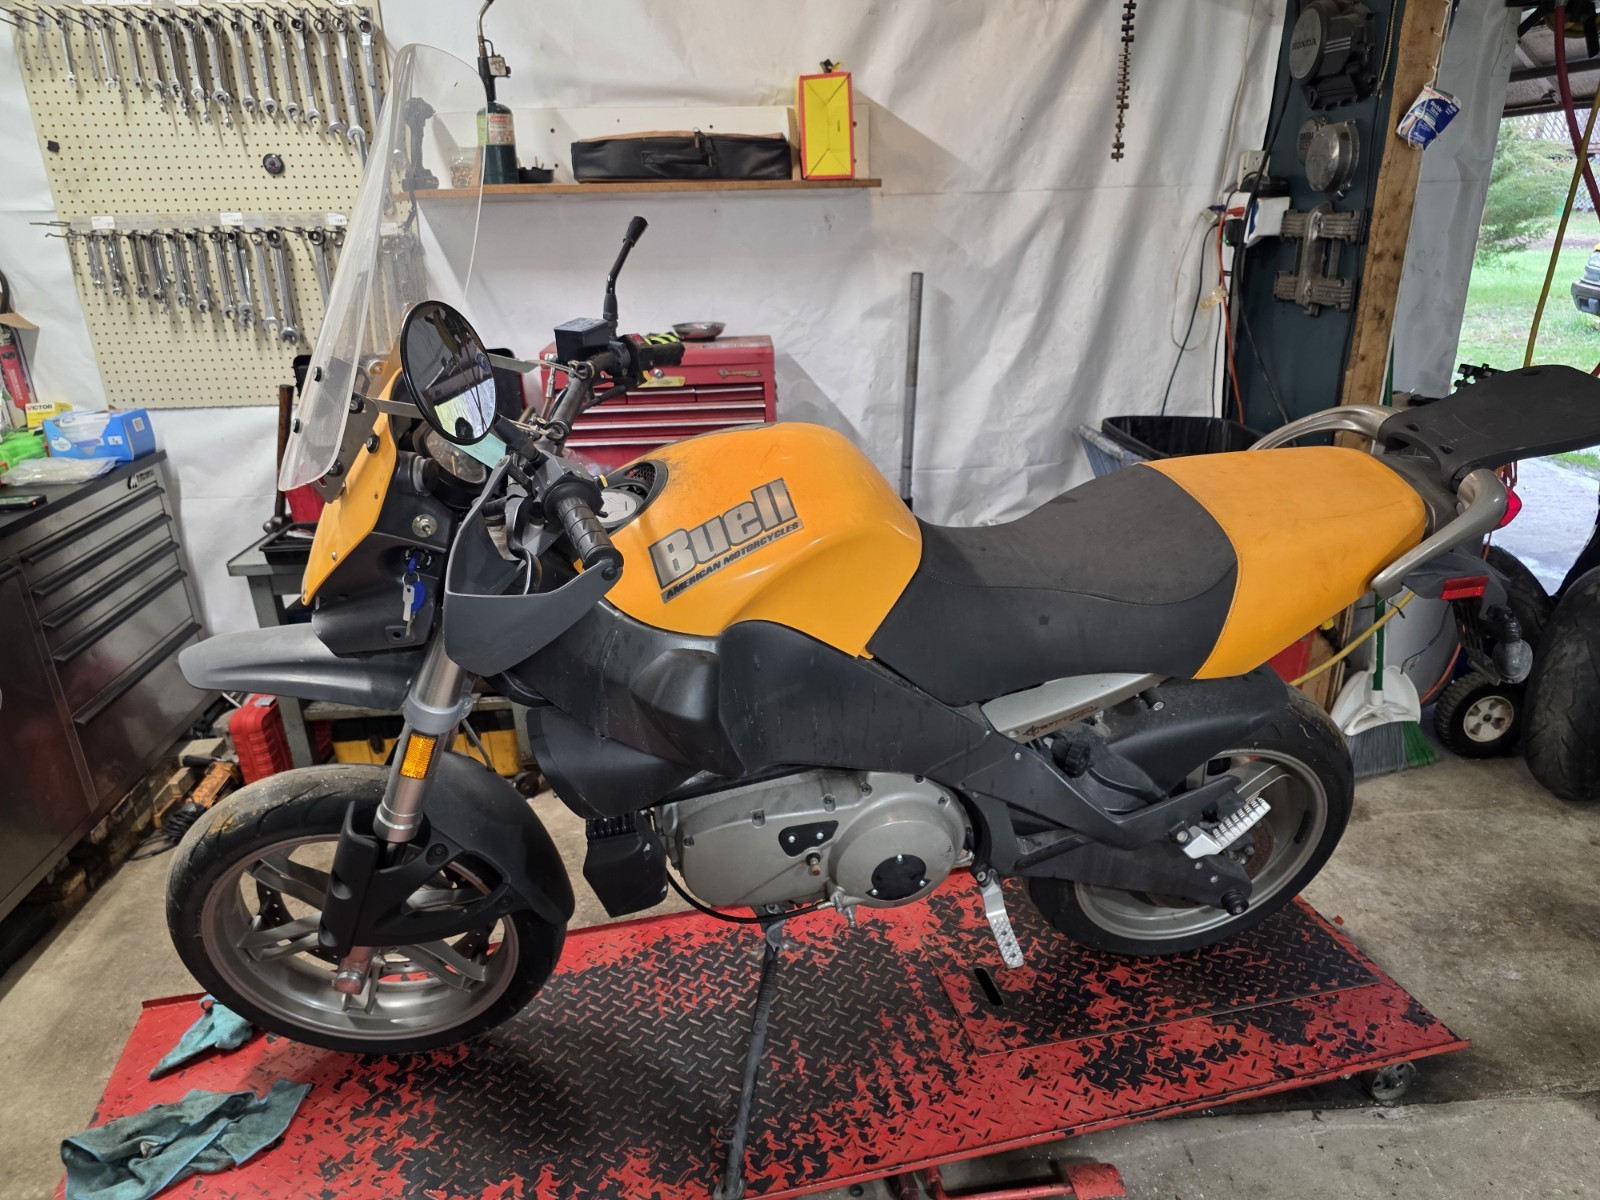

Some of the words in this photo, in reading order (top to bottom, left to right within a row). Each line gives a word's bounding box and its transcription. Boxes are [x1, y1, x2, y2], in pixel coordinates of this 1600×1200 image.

[1292, 38, 1317, 50] HONDA
[648, 477, 797, 590] Buell
[666, 560, 721, 600] AMERICAN
[723, 521, 799, 566] MOTORCYCLES
